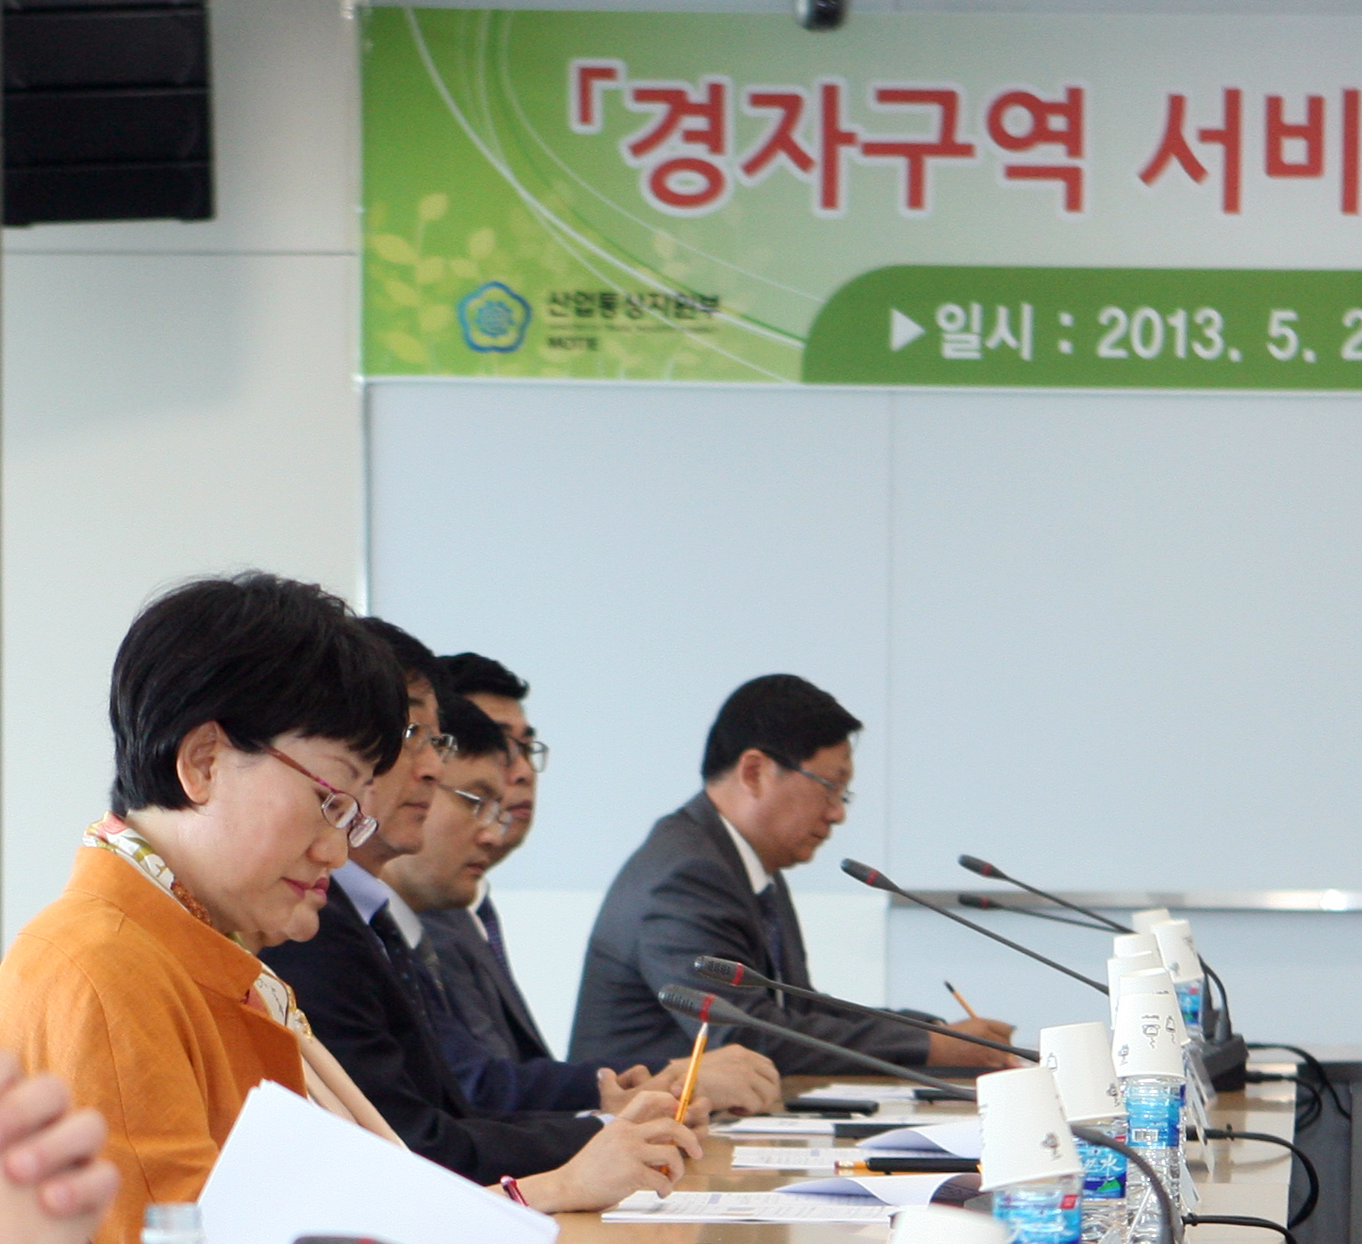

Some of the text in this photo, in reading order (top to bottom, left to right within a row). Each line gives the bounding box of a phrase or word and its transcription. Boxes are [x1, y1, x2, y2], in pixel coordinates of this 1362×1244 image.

[935, 301, 1035, 361] 일시
[1096, 305, 1244, 363] 2013.
[1266, 308, 1318, 363] 5.
